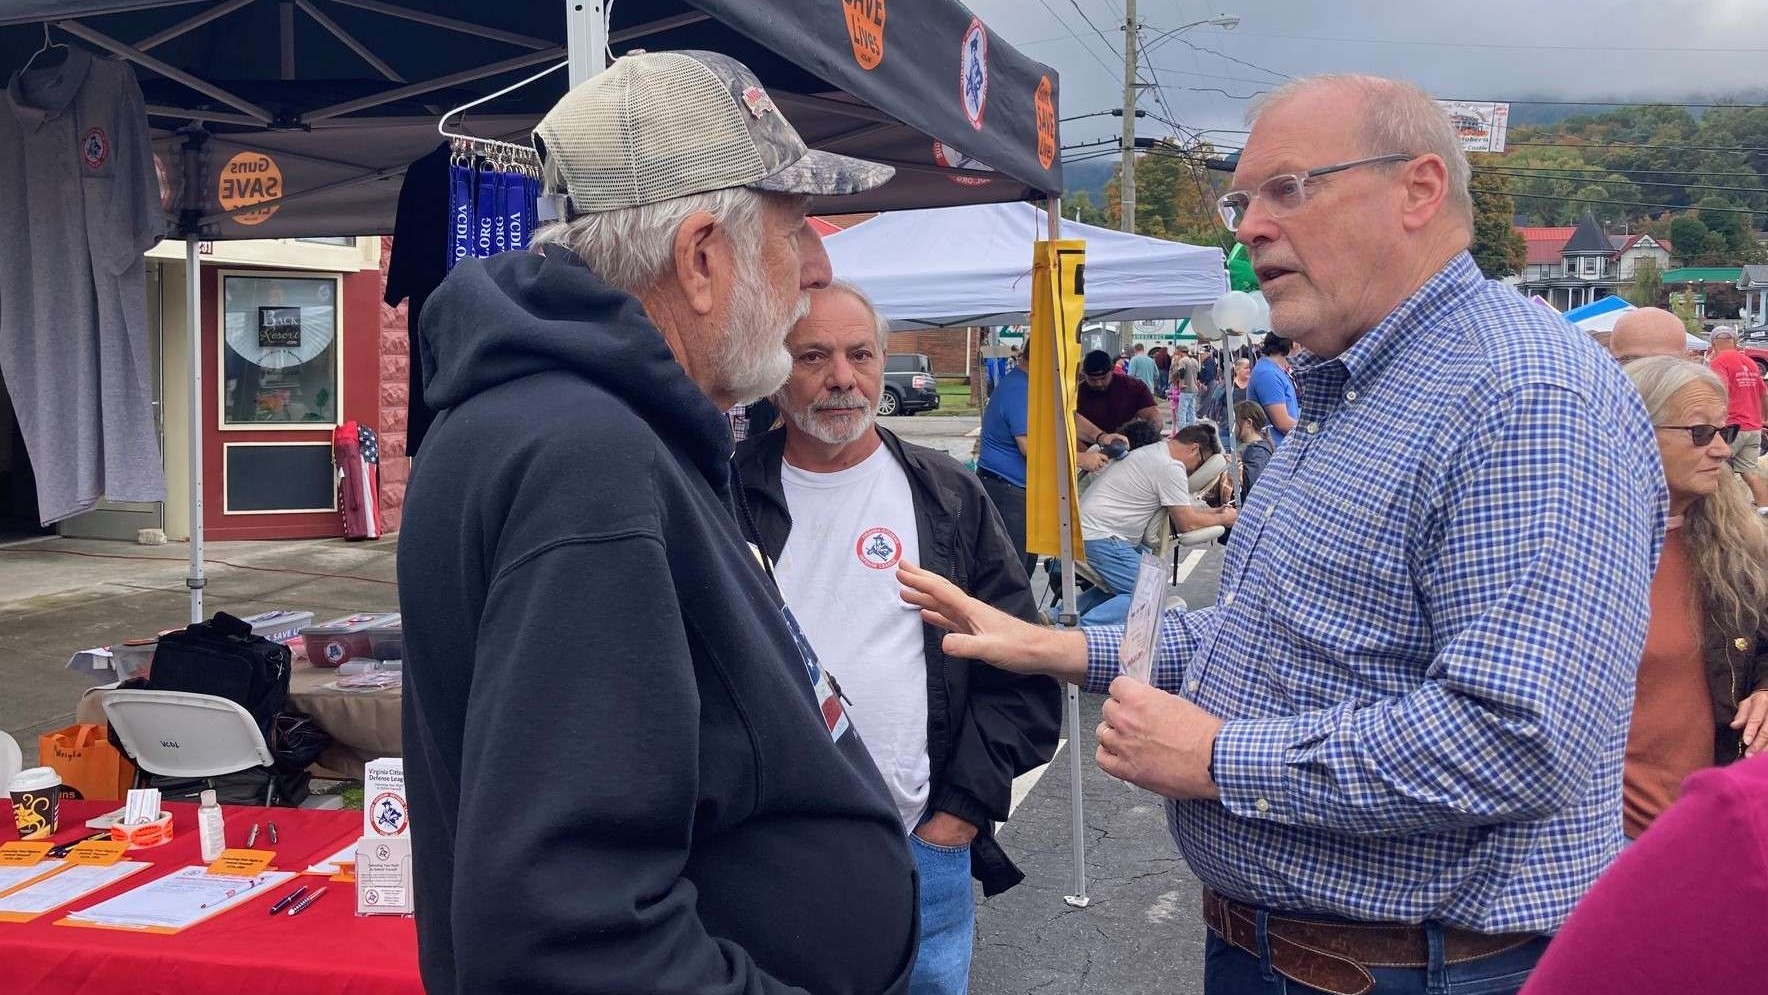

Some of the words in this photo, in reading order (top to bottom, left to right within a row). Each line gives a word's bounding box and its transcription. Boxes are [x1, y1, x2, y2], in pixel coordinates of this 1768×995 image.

[843, 0, 883, 28] AVE
[851, 14, 881, 56] Lives
[1037, 104, 1054, 139] SAVE
